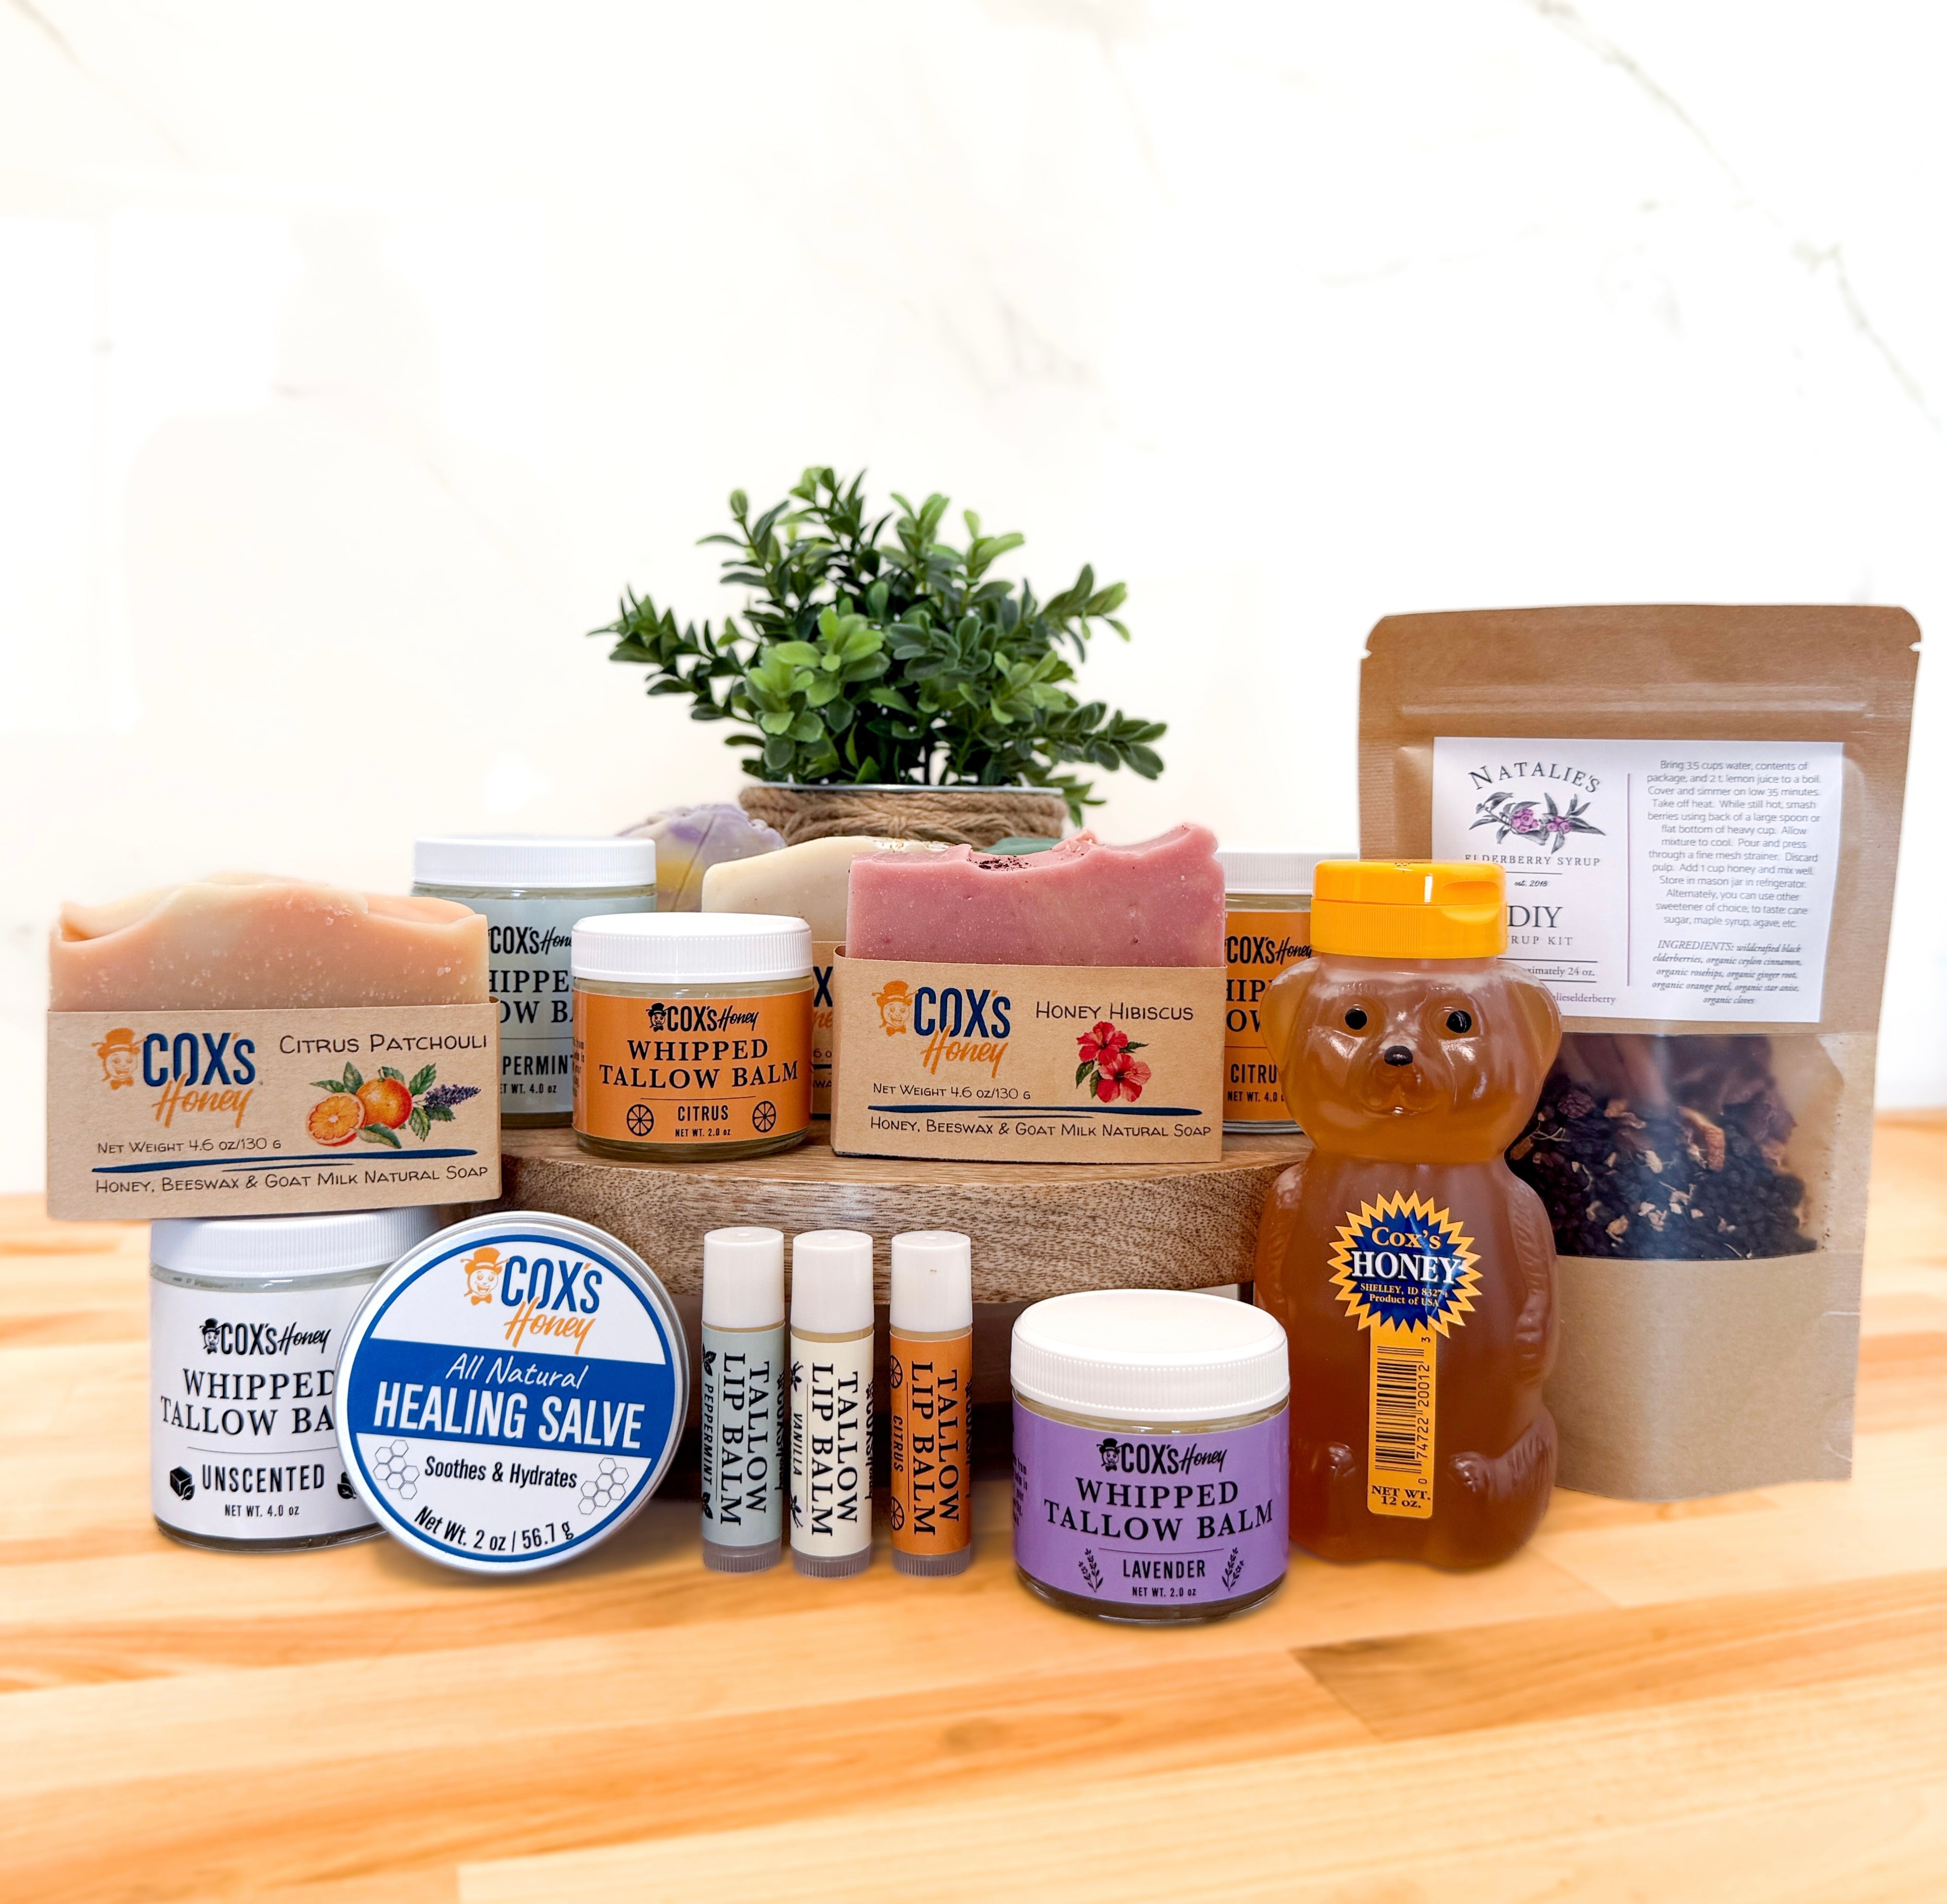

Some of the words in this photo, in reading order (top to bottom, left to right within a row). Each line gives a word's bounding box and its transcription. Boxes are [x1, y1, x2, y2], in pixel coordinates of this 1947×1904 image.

[1468, 762, 1600, 793] NATALIE'S
[1647, 774, 1687, 784] package,
[1757, 775, 1779, 784] juice
[1661, 760, 1683, 771] Bring
[1701, 762, 1723, 771] cups
[1725, 762, 1753, 770] water,
[1798, 761, 1808, 770] of
[1558, 857, 1600, 866] SYRUP
[1507, 905, 1563, 928] DIY
[1507, 935, 1539, 944] RUP
[1548, 936, 1573, 945] KIT
[1657, 940, 1734, 951] INGREDIENTS:
[1736, 944, 1780, 954] wildcrafted
[1781, 944, 1801, 953] black
[489, 970, 573, 993] HIPPE
[1525, 966, 1565, 977] ximately
[1568, 967, 1579, 975] 24
[717, 1005, 760, 1032] Honey
[1036, 1001, 1102, 1020] HONEY
[1110, 1002, 1194, 1021] HIBISCUS
[279, 1035, 359, 1055] CITRUS
[370, 1033, 488, 1053] PATCHOULI
[627, 1039, 768, 1061] WHIPPED
[920, 1025, 1009, 1079] Honey
[502, 1055, 573, 1075] PERMIN
[599, 1064, 720, 1089] TALLOW
[732, 1060, 798, 1087] BALM
[1231, 1064, 1277, 1084] CITRU
[151, 1073, 254, 1129] Honey
[511, 1084, 526, 1094] WT.
[529, 1083, 544, 1093] 4.0
[548, 1085, 557, 1093] oz
[873, 1083, 896, 1095] NET
[900, 1084, 947, 1097] WEIGHT
[950, 1087, 972, 1099] 4.6
[1228, 1091, 1243, 1102] NET
[1247, 1091, 1260, 1102] WT.
[1264, 1091, 1277, 1102] 4.0
[677, 1105, 729, 1122] CITRUS
[926, 1119, 993, 1134] BEESWAX
[999, 1123, 1009, 1135] &
[1015, 1122, 1055, 1136] GOAT
[1061, 1123, 1096, 1137] MILK
[1102, 1123, 1168, 1137] NATURAL
[1174, 1124, 1211, 1137] SOAP
[97, 1142, 125, 1154] NET
[129, 1141, 183, 1153] WEIGHT
[189, 1139, 213, 1151] 4.6
[675, 1128, 688, 1137] NET
[691, 1128, 704, 1137] WT.
[708, 1127, 720, 1137] 2.0
[162, 1177, 239, 1192] BEESWAX
[246, 1176, 258, 1188] &
[265, 1174, 310, 1187] GOAT
[317, 1171, 358, 1186] MILK
[365, 1169, 441, 1184] NATURAL
[447, 1165, 488, 1180] SOAP
[1351, 1251, 1461, 1284] HONEY
[1361, 1283, 1403, 1295] SHELLEY,
[1408, 1287, 1418, 1295] ID
[1370, 1293, 1405, 1304] Product
[1421, 1298, 1439, 1306] USA
[277, 1322, 331, 1355] Honey
[503, 1297, 596, 1355] Honey
[183, 1368, 334, 1400] WHIPPED
[445, 1352, 483, 1380] All
[486, 1356, 589, 1389] Natural
[724, 1352, 745, 1411] LIP
[812, 1363, 834, 1421] LIP
[911, 1361, 934, 1420] LIP
[1418, 1365, 1430, 1407] 20012
[161, 1396, 278, 1436] TALLOW
[292, 1405, 334, 1434] BA
[374, 1381, 527, 1439] HEALING
[538, 1396, 644, 1448] SALVE
[703, 1383, 714, 1485] PEPPERMINT
[746, 1361, 770, 1513] TALLOW
[794, 1413, 803, 1476] VANILLA
[837, 1371, 858, 1523] TALLOW
[893, 1415, 904, 1472] CITRUS
[938, 1369, 959, 1522] TALLOW
[1417, 1418, 1429, 1458] 74722
[425, 1456, 486, 1482] Soothes
[492, 1463, 503, 1482] &
[510, 1464, 577, 1488] Hydrates
[1179, 1443, 1227, 1475] Honey
[202, 1463, 324, 1493] UNSCENTED
[720, 1424, 744, 1526] BALM
[811, 1434, 834, 1536] BALM
[913, 1434, 935, 1535] BALM
[1075, 1477, 1238, 1509] WHIPPED
[1372, 1485, 1399, 1496] NET
[1404, 1489, 1430, 1500] WT.
[1381, 1496, 1397, 1505] 12
[1401, 1500, 1421, 1508] oz.
[225, 1504, 241, 1517] NET
[246, 1505, 262, 1517] WT.
[268, 1505, 283, 1517] 4.0
[289, 1506, 299, 1516] oz
[1044, 1499, 1183, 1541] TALLOW
[1197, 1499, 1273, 1539] BALM
[414, 1506, 443, 1533] Net
[445, 1522, 467, 1547] Wt.
[474, 1530, 484, 1550] 2
[490, 1534, 506, 1551] oz
[511, 1530, 516, 1553] /
[522, 1524, 556, 1550] 56.7
[562, 1521, 574, 1540] g
[1123, 1559, 1205, 1579] LAVENDER
[1132, 1587, 1147, 1596] NET
[1151, 1587, 1166, 1597] WT.
[1170, 1587, 1184, 1597] 2.0
[1187, 1588, 1196, 1596] oz
